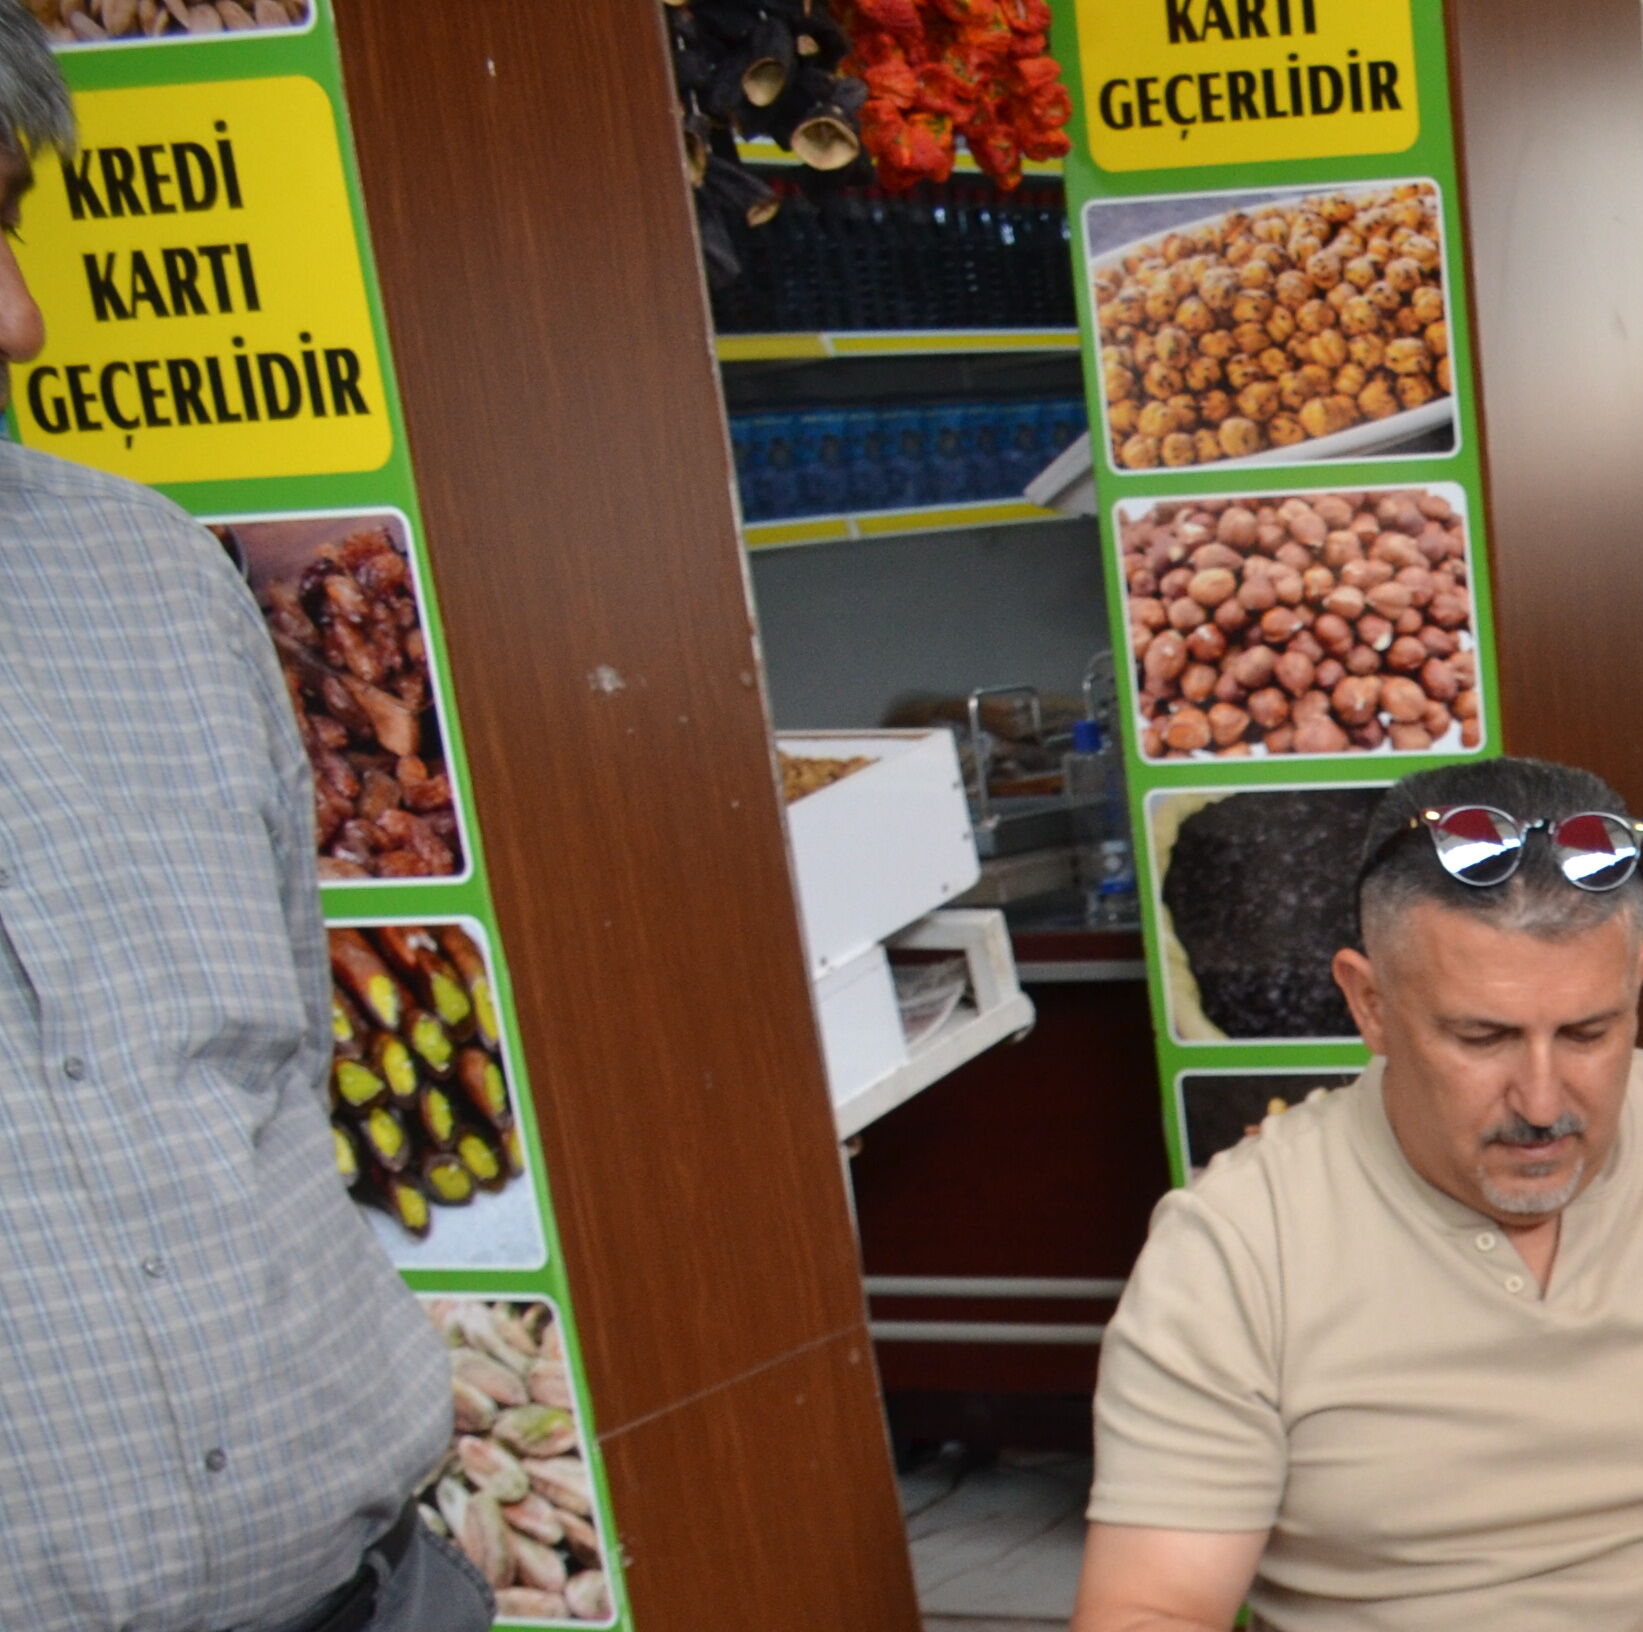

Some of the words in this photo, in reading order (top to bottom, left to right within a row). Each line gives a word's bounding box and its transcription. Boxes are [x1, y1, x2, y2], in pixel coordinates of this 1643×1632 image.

[1098, 49, 1402, 141] GEÇERLİDİR
[61, 119, 244, 222] KREDİ
[83, 243, 261, 323] KARTI
[27, 331, 371, 450] GEÇERLİDİR
